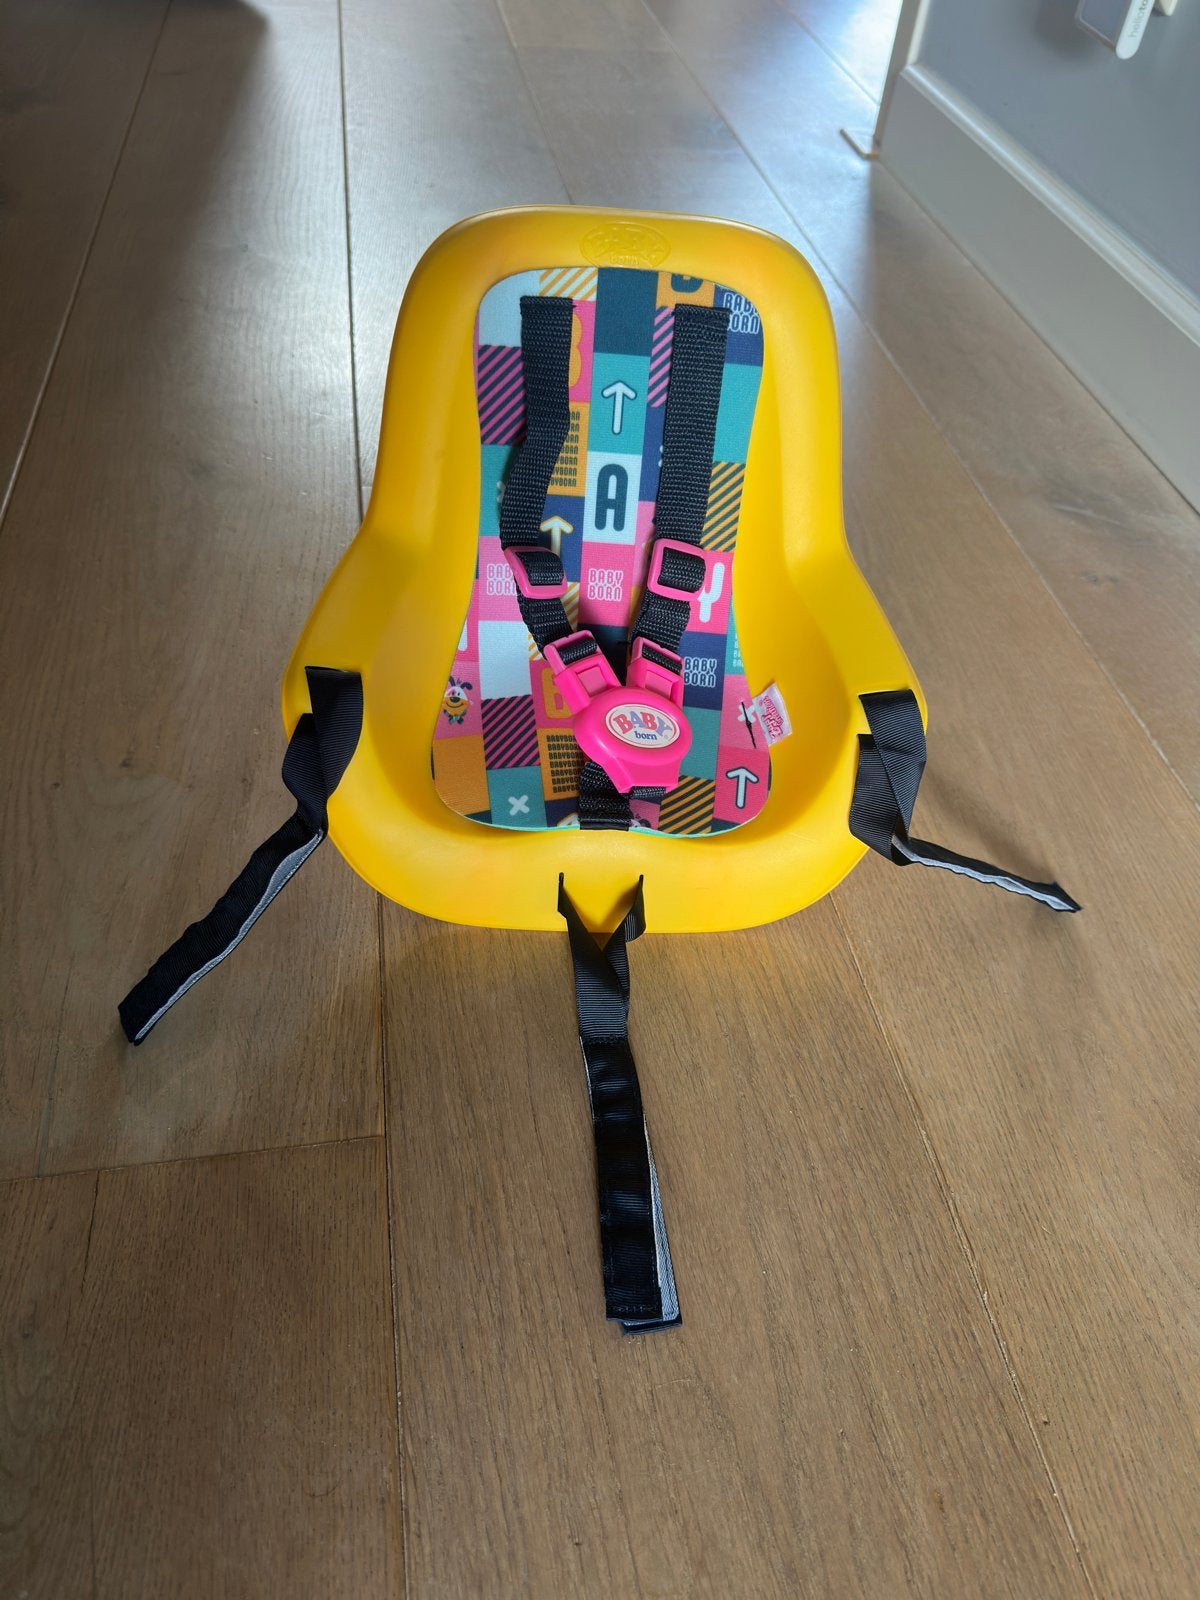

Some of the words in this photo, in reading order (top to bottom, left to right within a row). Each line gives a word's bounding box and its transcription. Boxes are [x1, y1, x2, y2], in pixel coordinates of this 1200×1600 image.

[727, 312, 760, 334] ORN
[595, 463, 628, 532] A
[487, 564, 514, 579] BAB
[588, 568, 624, 585] BABY
[588, 584, 622, 601] BORN
[684, 656, 717, 674] BABY
[684, 671, 716, 688] BORN
[613, 711, 673, 737] BABY
[634, 730, 657, 740] born
